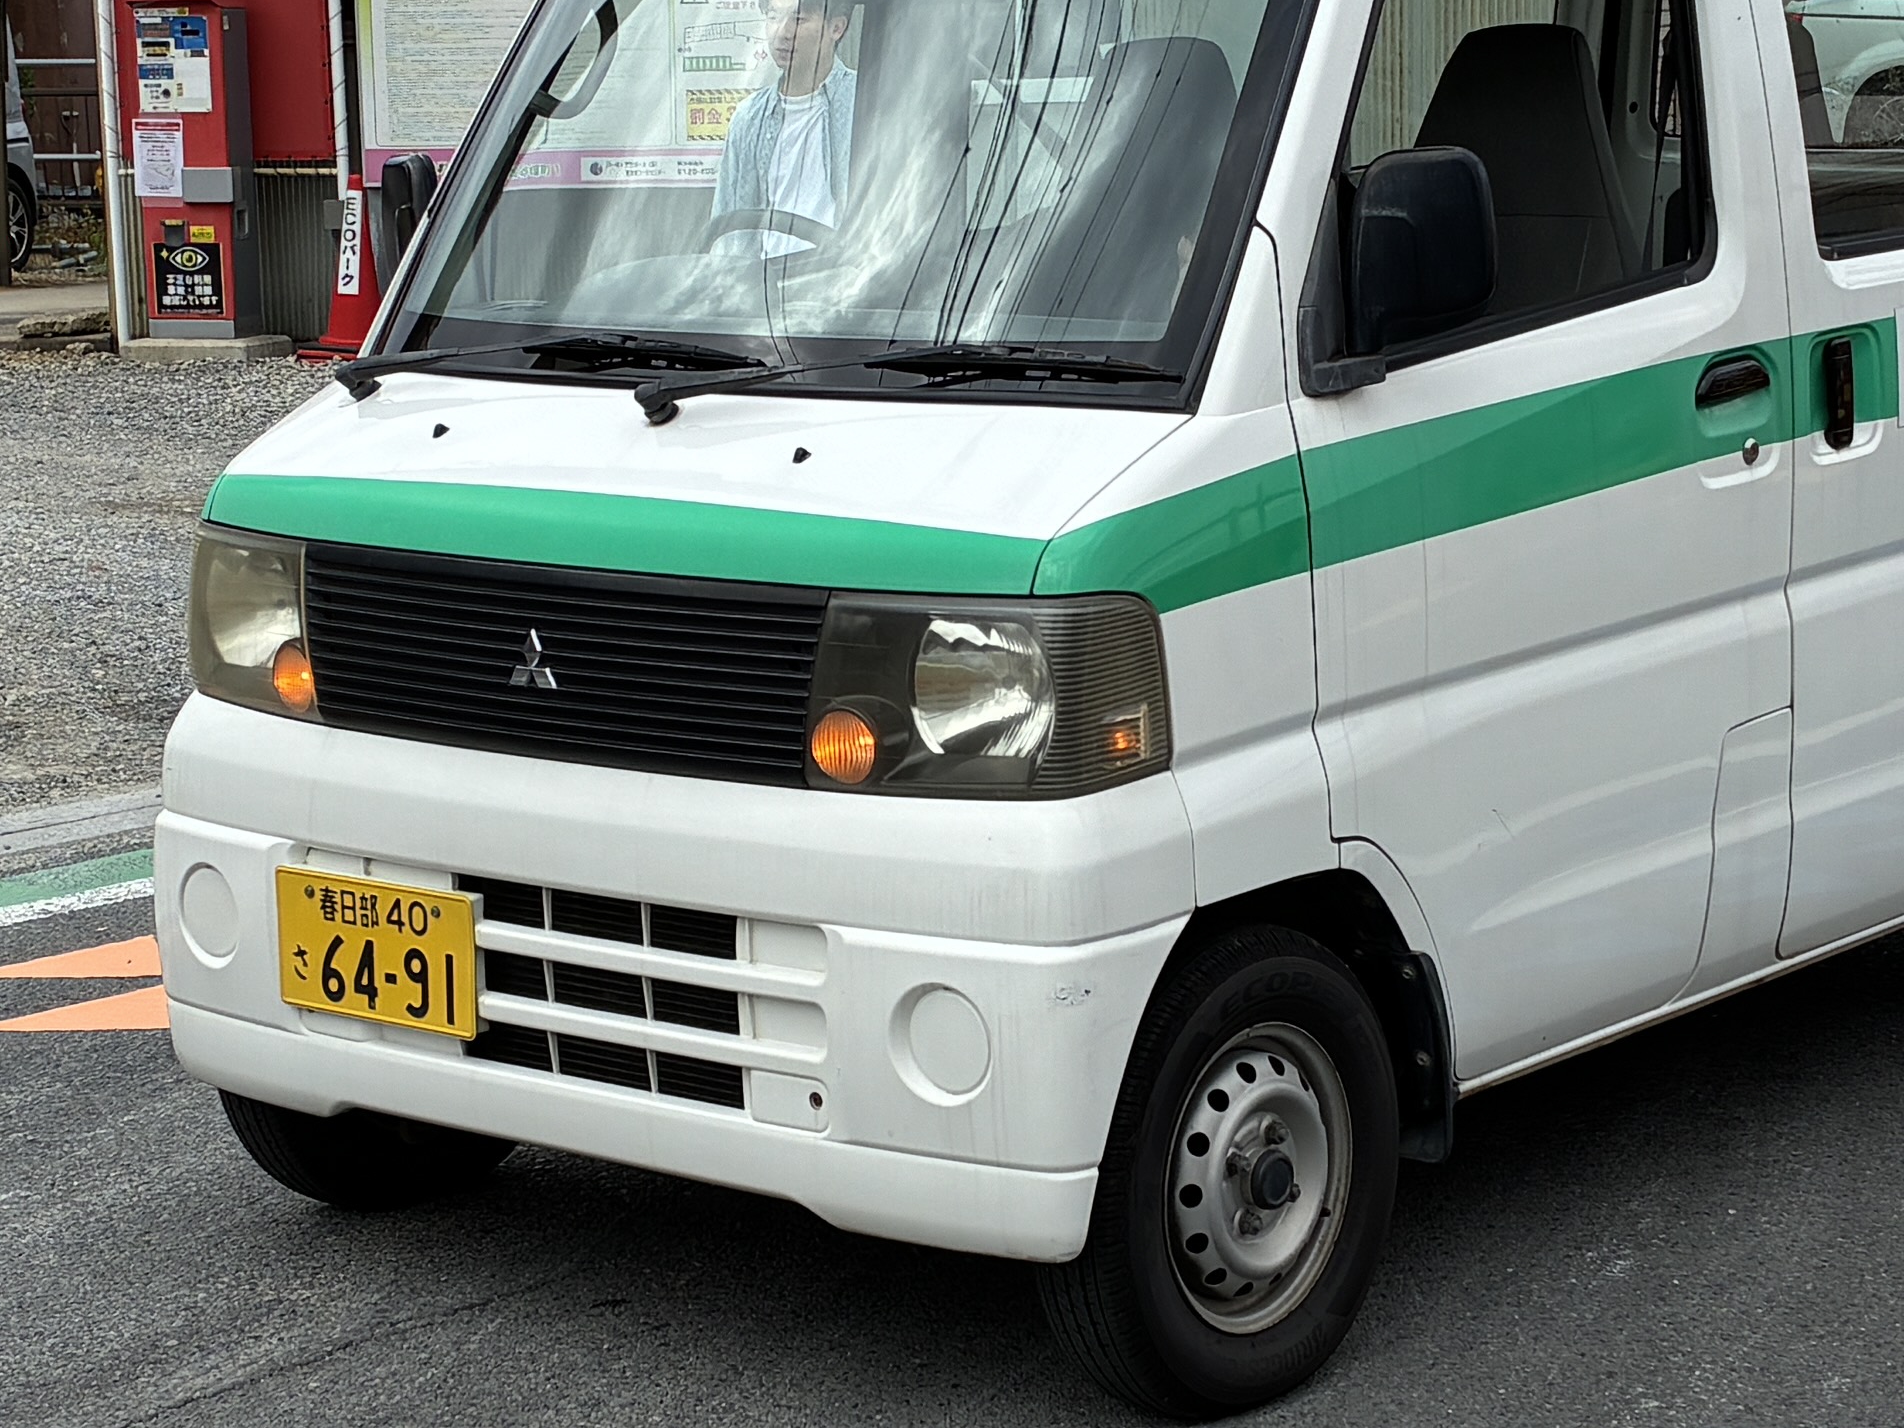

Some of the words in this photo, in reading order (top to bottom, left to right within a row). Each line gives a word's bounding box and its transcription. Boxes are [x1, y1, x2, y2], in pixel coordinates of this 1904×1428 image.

[340, 196, 358, 287] ECOパーク
[318, 885, 380, 929] 春日部
[385, 897, 429, 938] 40
[291, 943, 309, 981] さ
[321, 934, 456, 1027] 64-91
